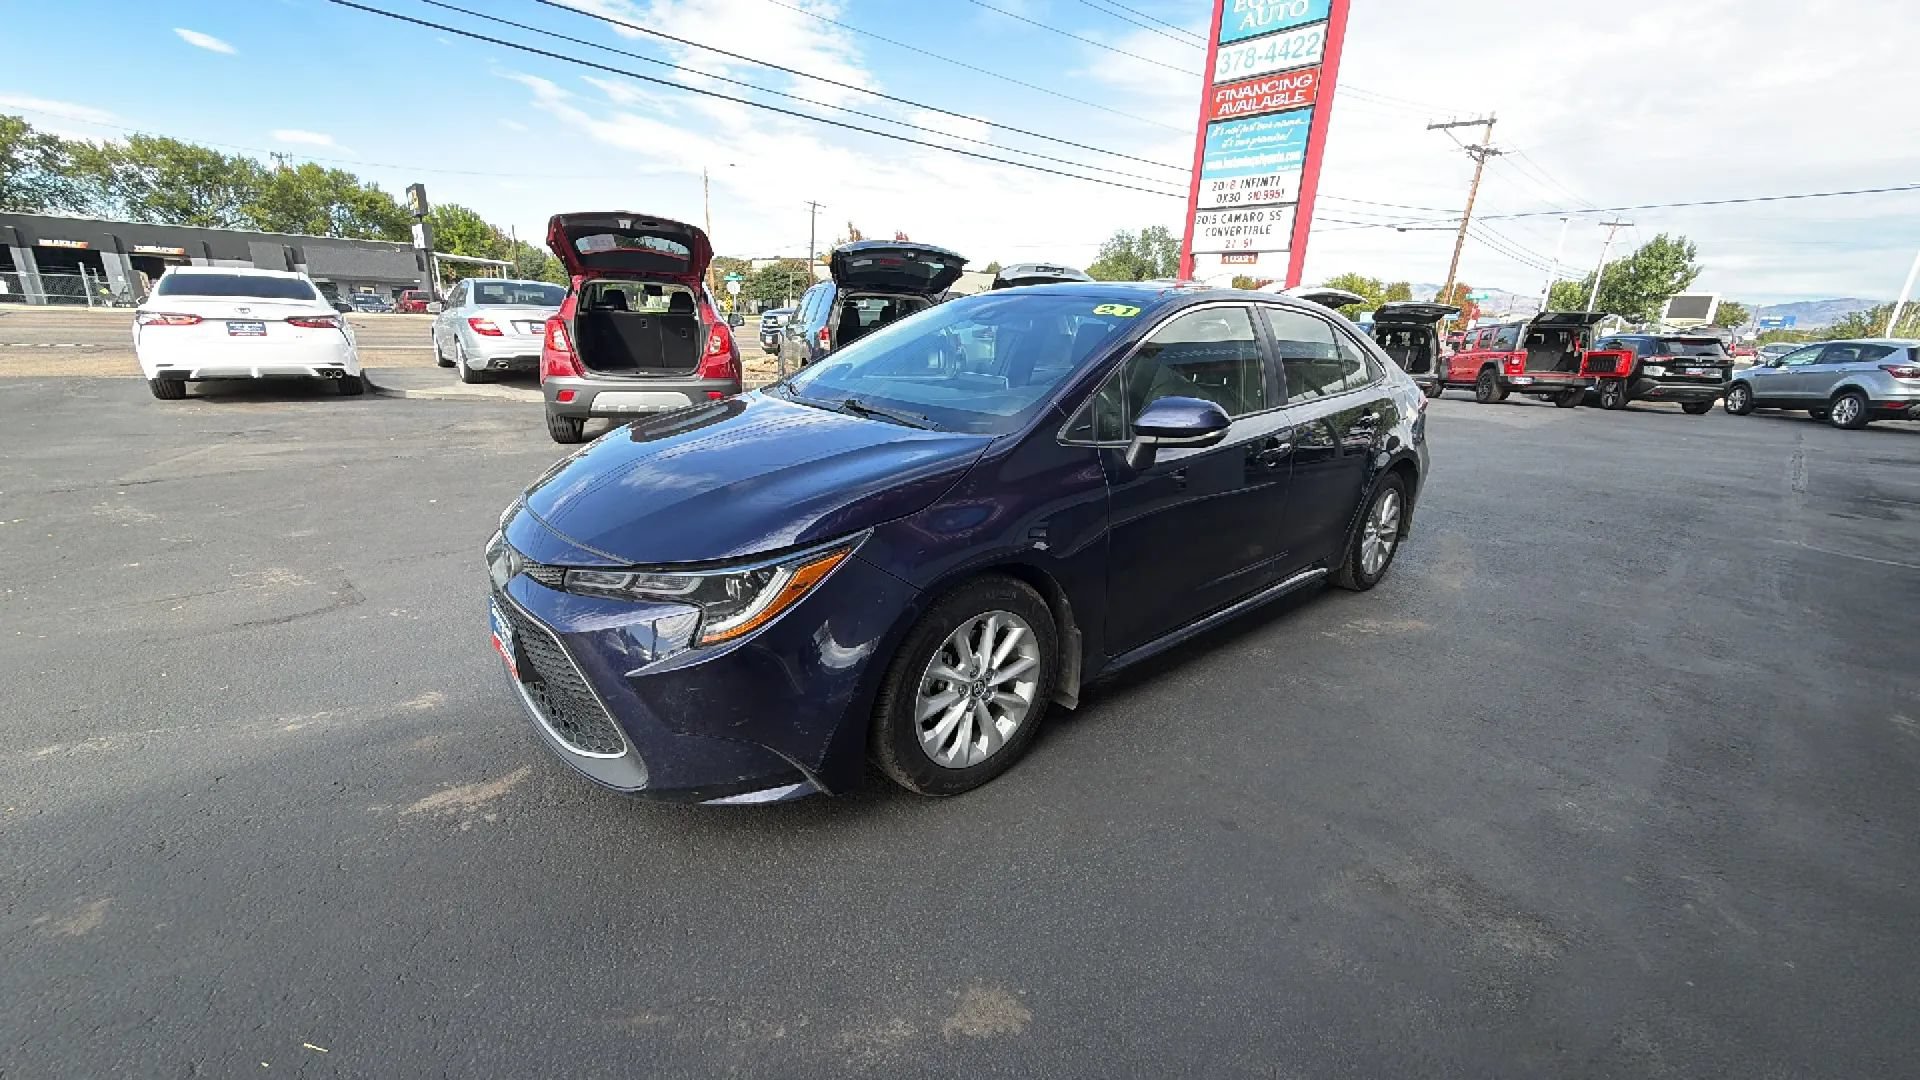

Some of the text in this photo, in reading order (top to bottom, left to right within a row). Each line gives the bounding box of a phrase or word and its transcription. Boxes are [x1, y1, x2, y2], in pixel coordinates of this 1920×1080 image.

[1239, 1, 1309, 31] AUTO
[1219, 32, 1321, 75] 378-4422
[1215, 73, 1313, 103] FINANCING
[1217, 90, 1308, 115] AVAILABLE
[1220, 211, 1264, 224] CAMARO
[1269, 210, 1284, 221] SS
